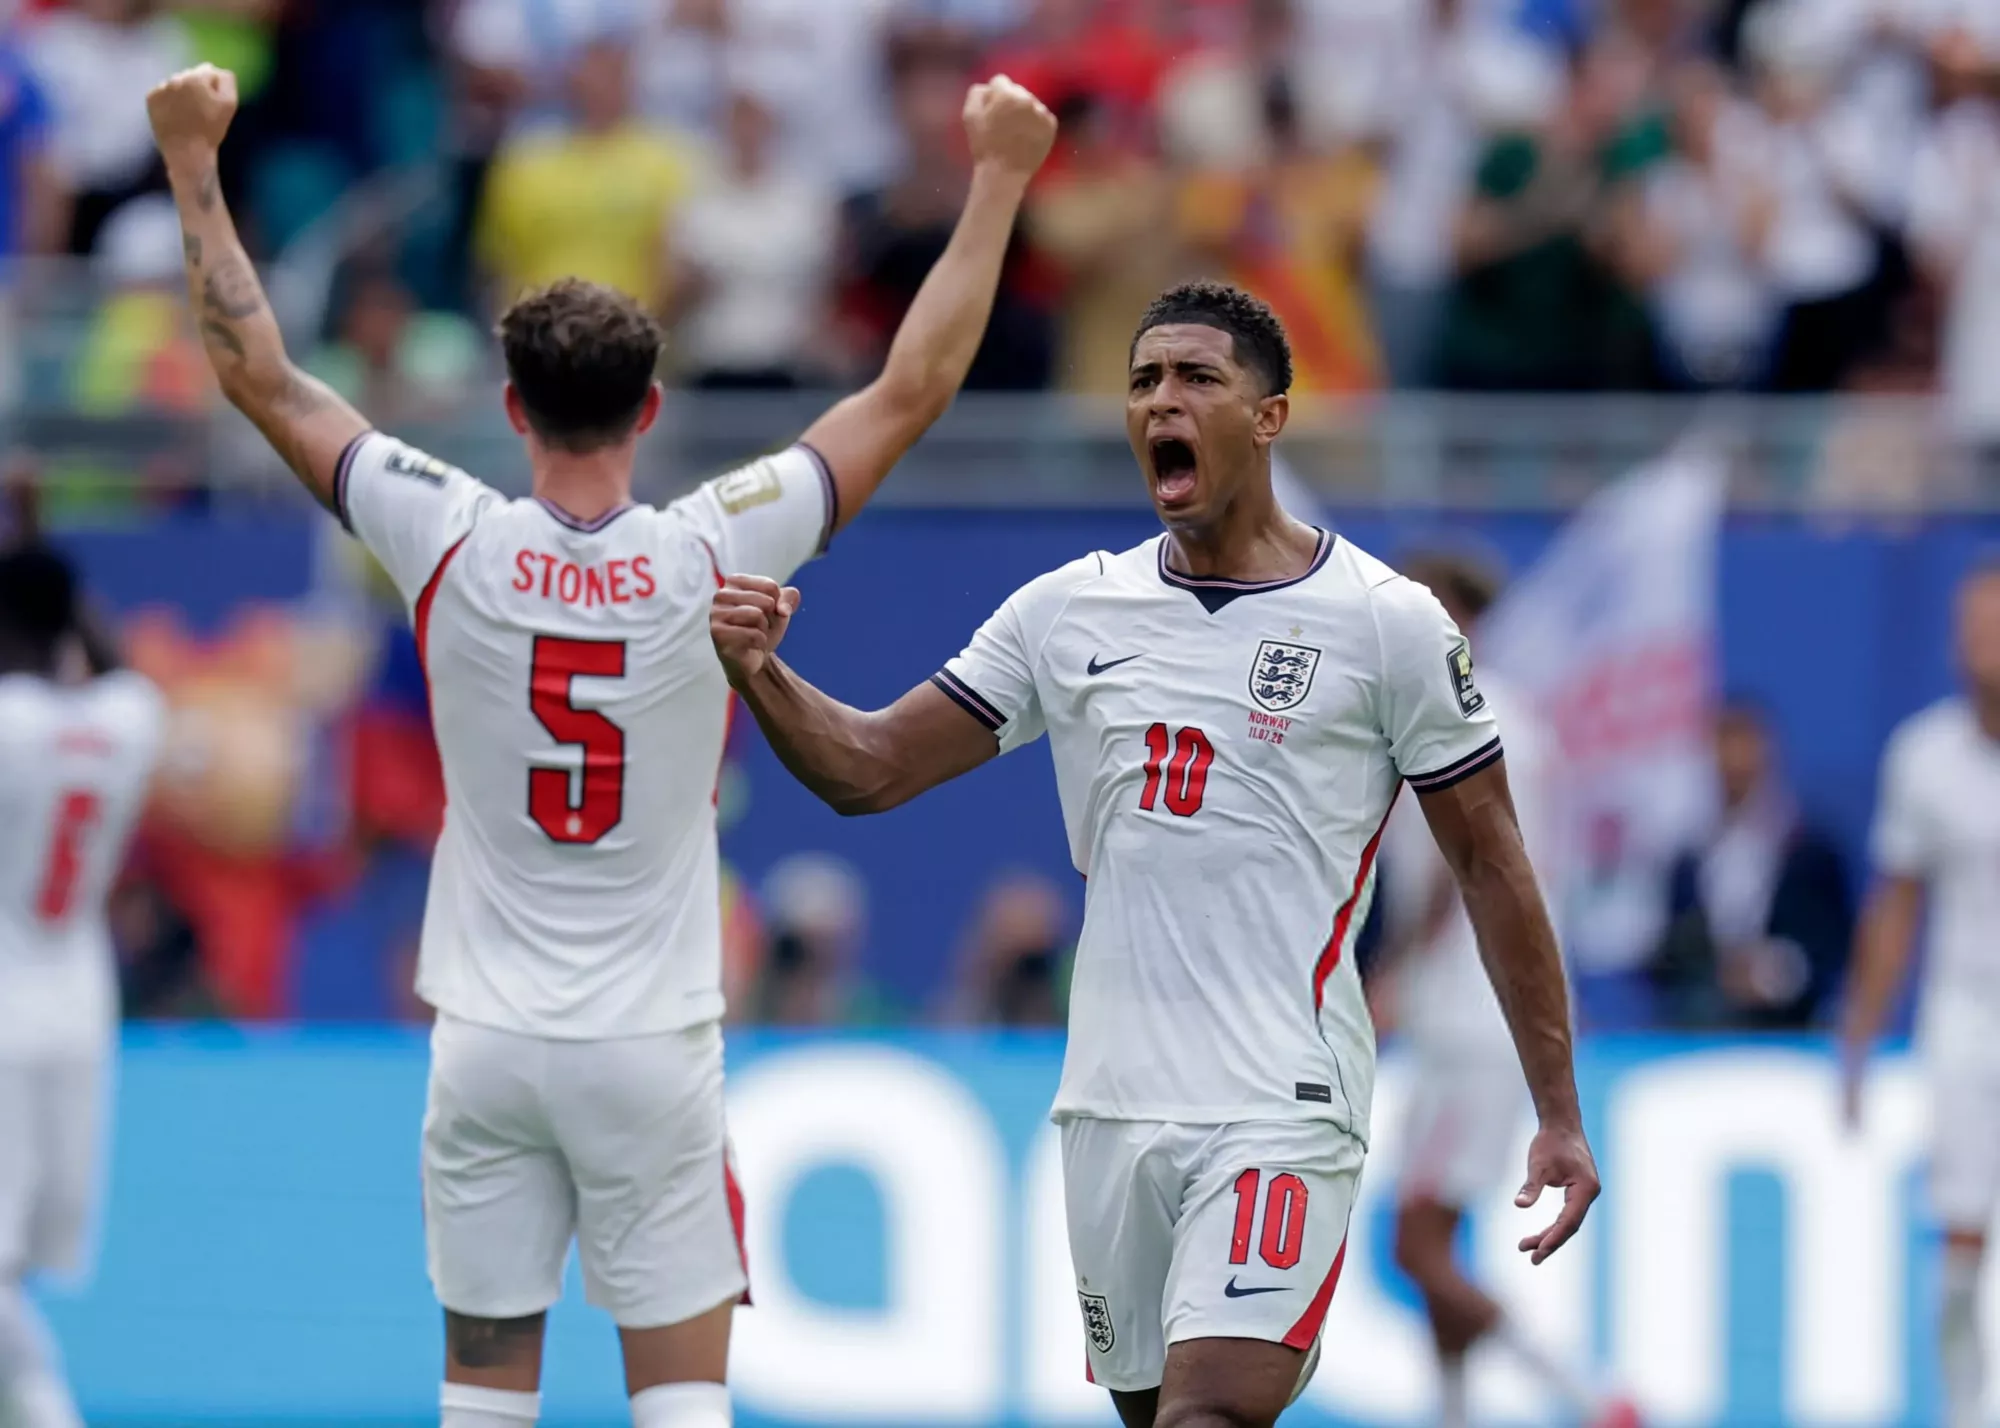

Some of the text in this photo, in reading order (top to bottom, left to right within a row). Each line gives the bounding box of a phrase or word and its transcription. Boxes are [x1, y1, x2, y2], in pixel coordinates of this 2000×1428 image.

[512, 549, 656, 607] STONES
[529, 635, 626, 843] 5
[1248, 711, 1292, 732] NORWAY
[1248, 726, 1284, 745] 11.07.26
[1139, 722, 1214, 817] 10
[1229, 1168, 1308, 1270] 10
